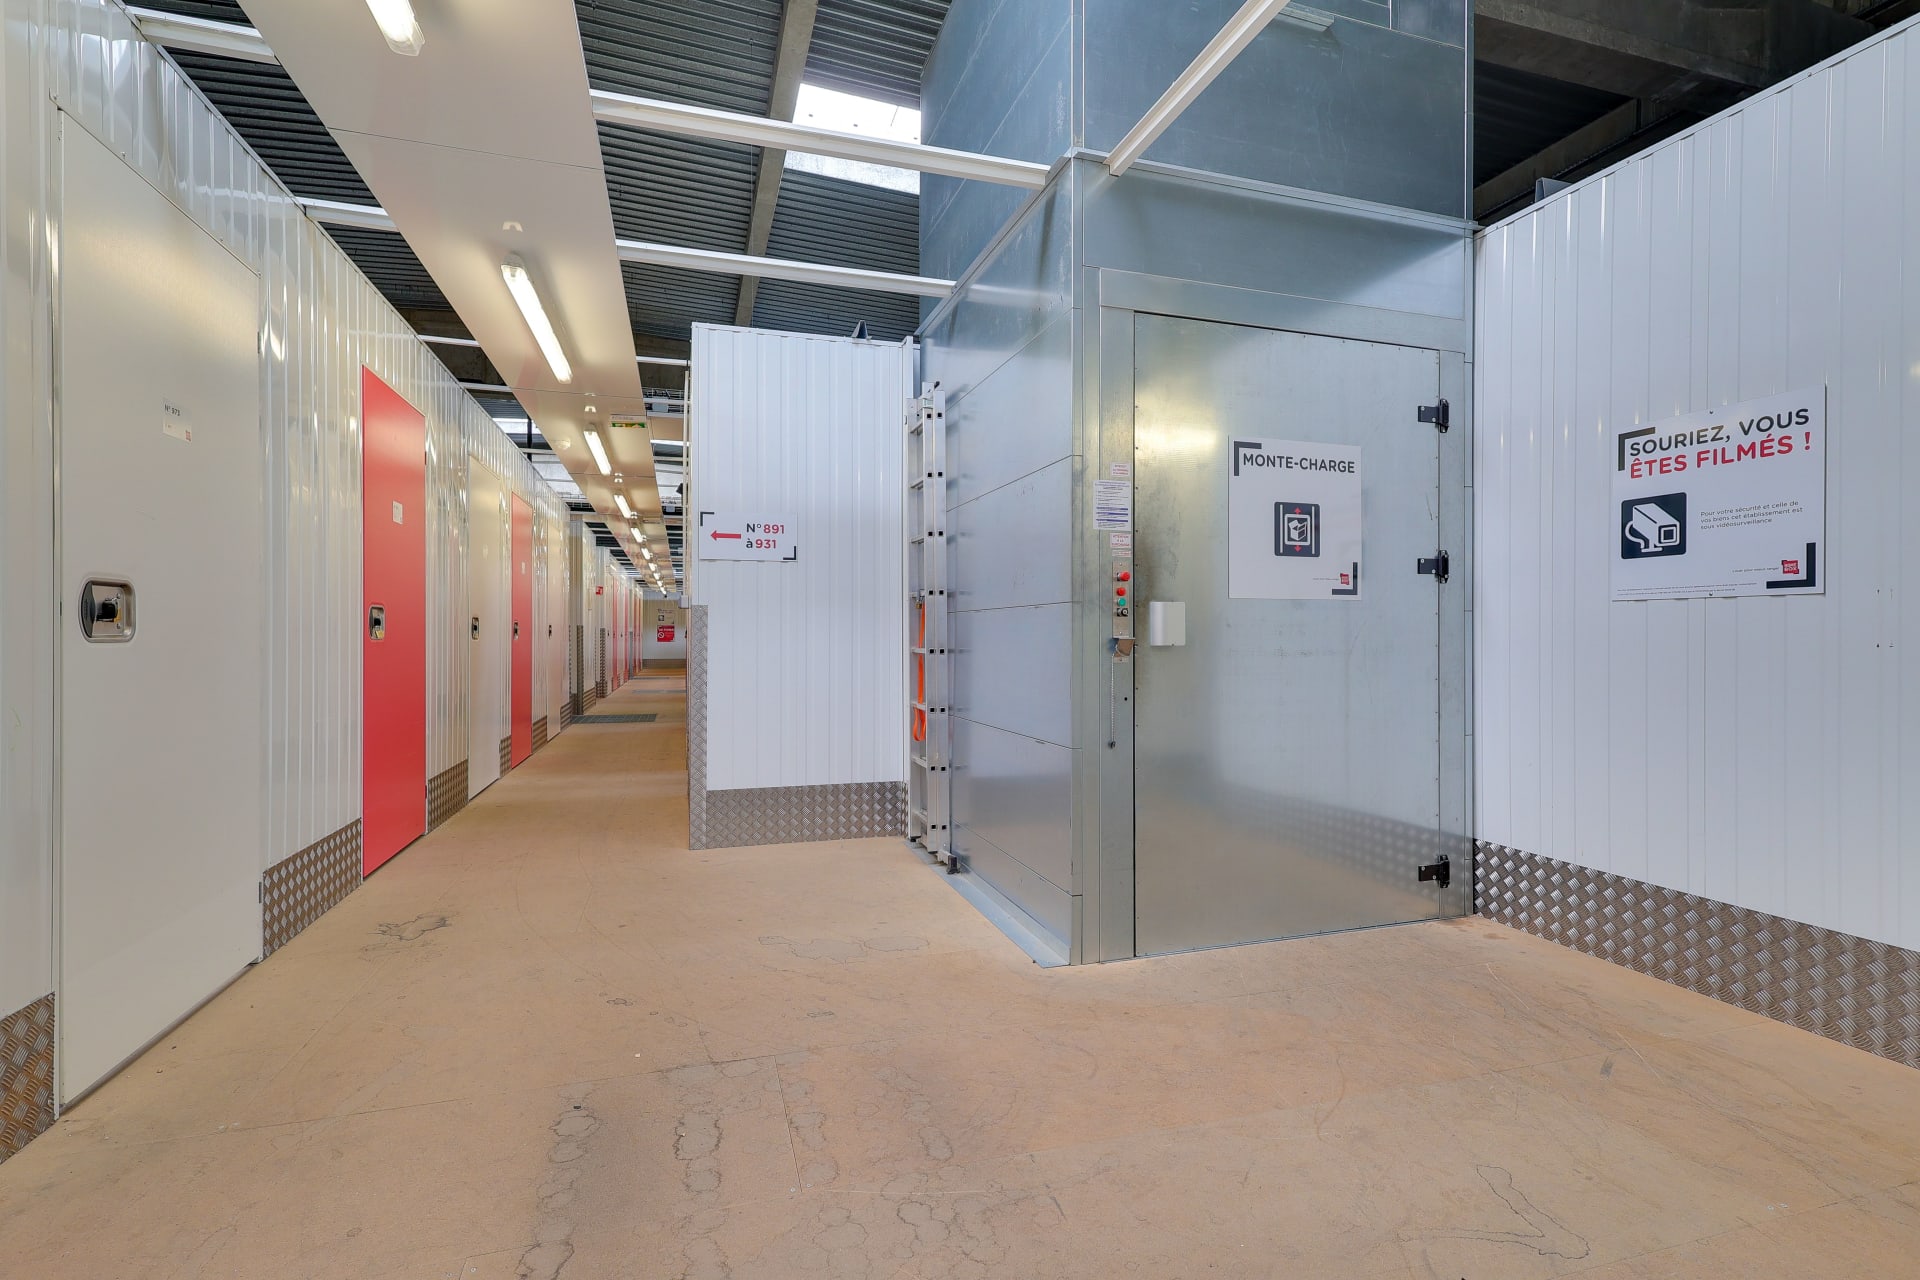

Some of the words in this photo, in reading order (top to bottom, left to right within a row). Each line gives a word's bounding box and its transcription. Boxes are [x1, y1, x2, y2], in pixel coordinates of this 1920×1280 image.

[1630, 425, 1731, 456] SOURIEZ,
[1739, 409, 1810, 436] VOUS
[1243, 453, 1355, 473] MONTE-CHARGE
[1630, 454, 1687, 479] ÊTES
[1697, 433, 1793, 468] FILMÉS
[1716, 508, 1734, 516] votre
[1735, 504, 1761, 513] sécurité
[1743, 509, 1790, 519] établissement
[746, 538, 753, 549] à
[755, 539, 776, 549] 931
